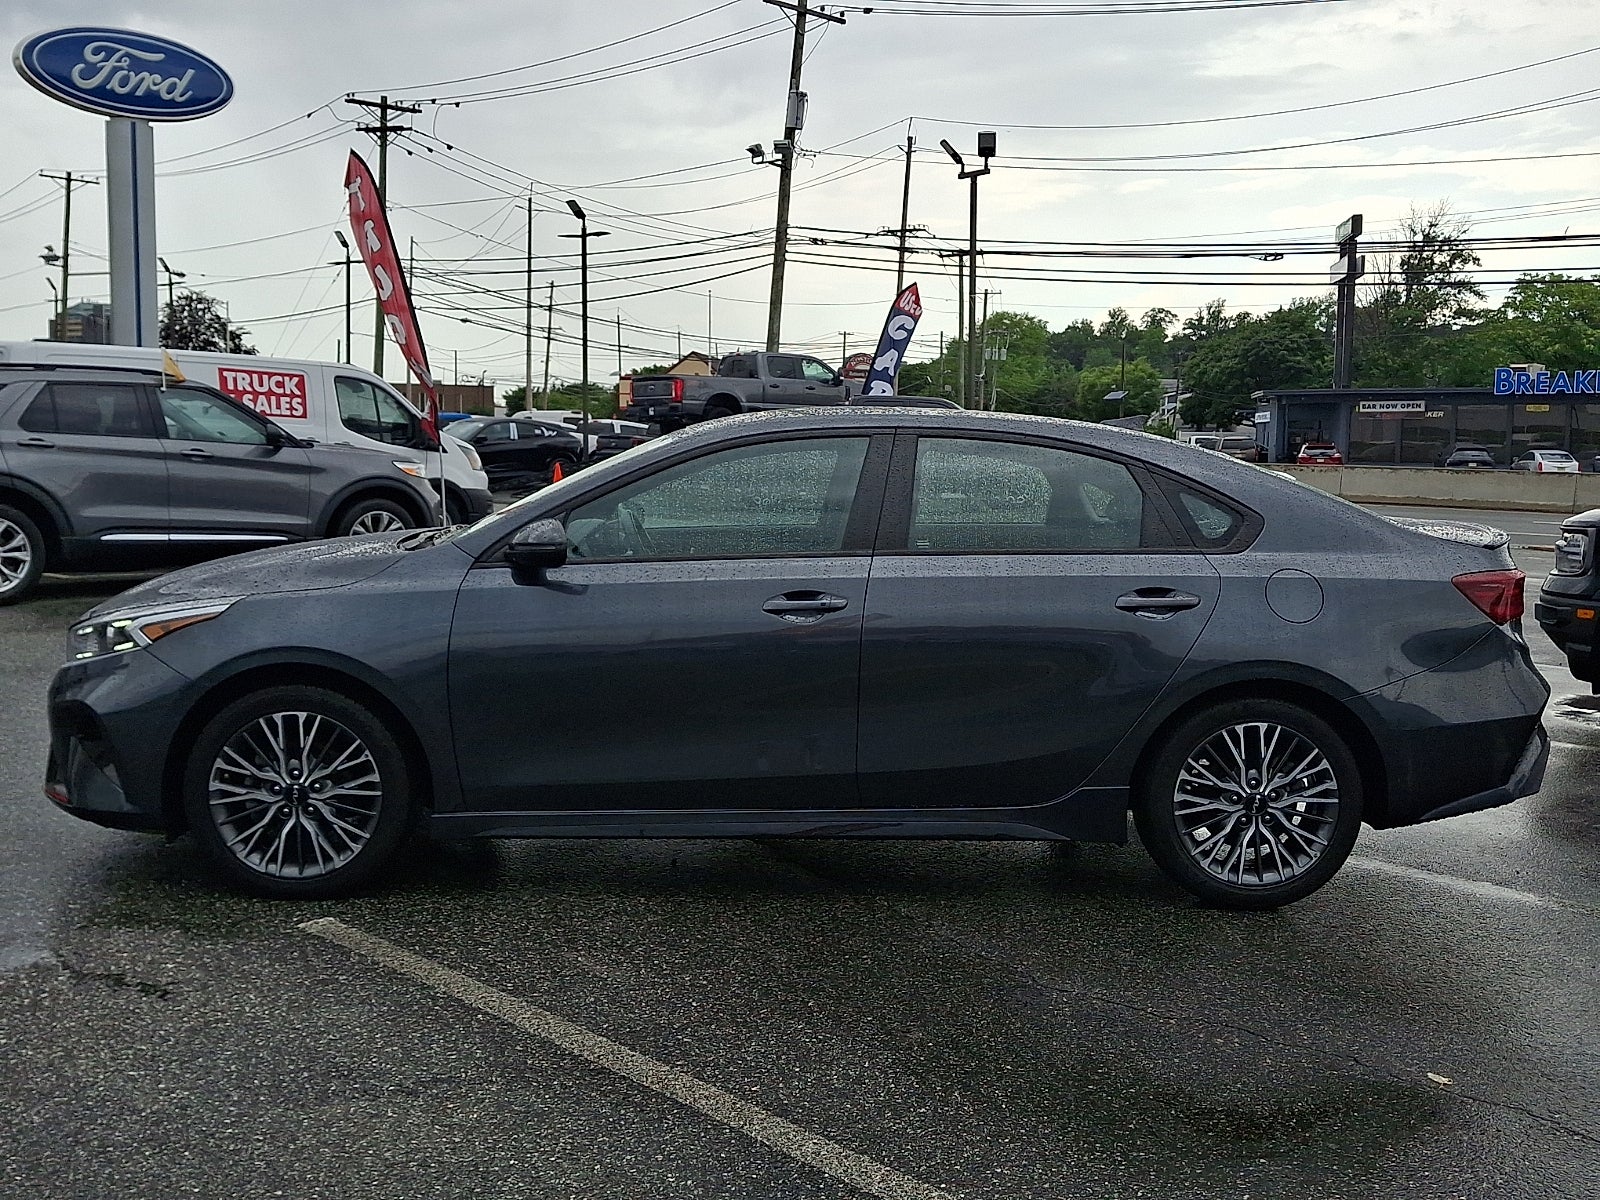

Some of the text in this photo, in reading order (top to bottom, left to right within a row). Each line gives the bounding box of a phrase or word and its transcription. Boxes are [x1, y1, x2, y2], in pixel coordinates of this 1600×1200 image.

[71, 41, 194, 102] Ford
[222, 371, 301, 395] TRUCK
[1494, 367, 1600, 395] BREAK
[242, 394, 304, 416] SALES
